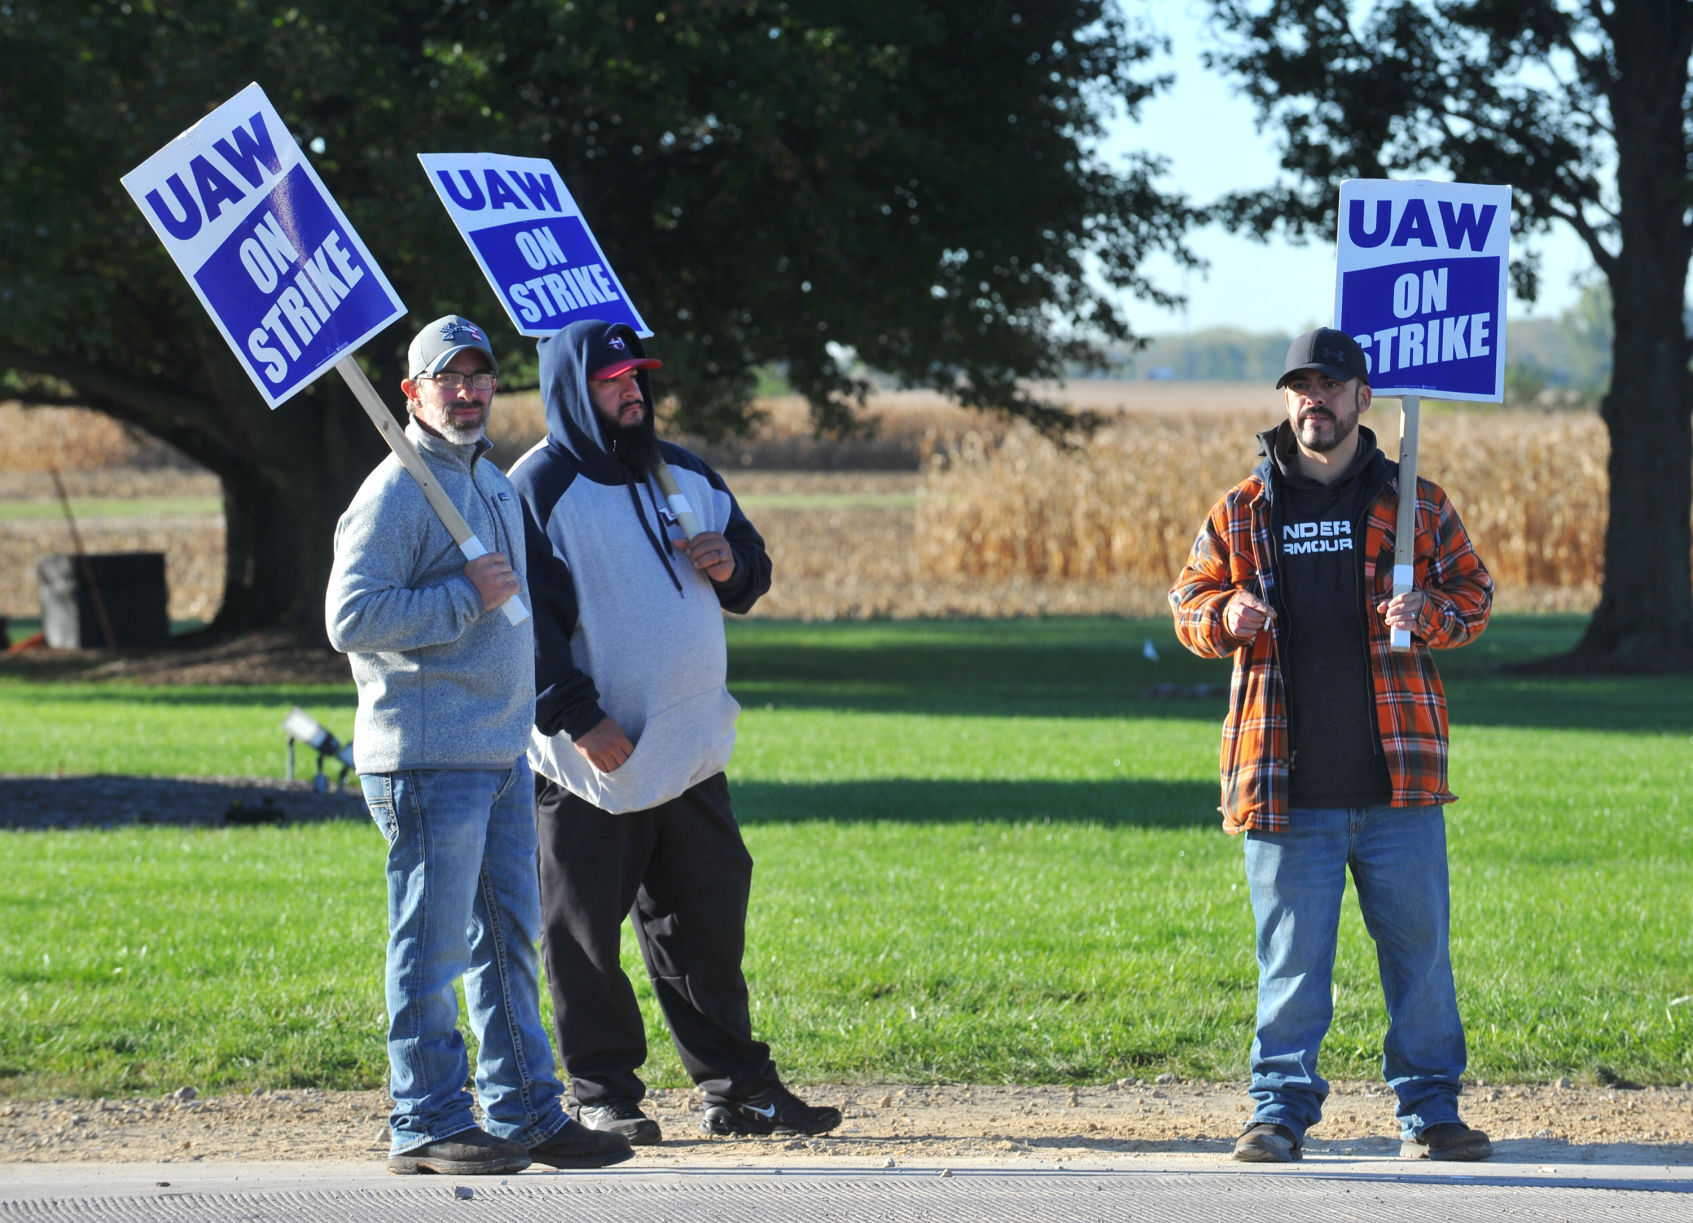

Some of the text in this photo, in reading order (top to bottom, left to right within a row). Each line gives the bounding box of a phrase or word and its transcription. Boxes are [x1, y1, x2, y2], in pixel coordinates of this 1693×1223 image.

[145, 111, 282, 240] UAW
[436, 169, 562, 212] UAW
[515, 226, 567, 270] ON
[1348, 199, 1498, 252] UAW
[239, 210, 299, 294] ON
[248, 229, 364, 384] STRIKE
[509, 264, 619, 323] STRIKE
[1393, 267, 1448, 319] ON
[1283, 520, 1352, 540] NDER
[1283, 538, 1353, 555] RMOUR
